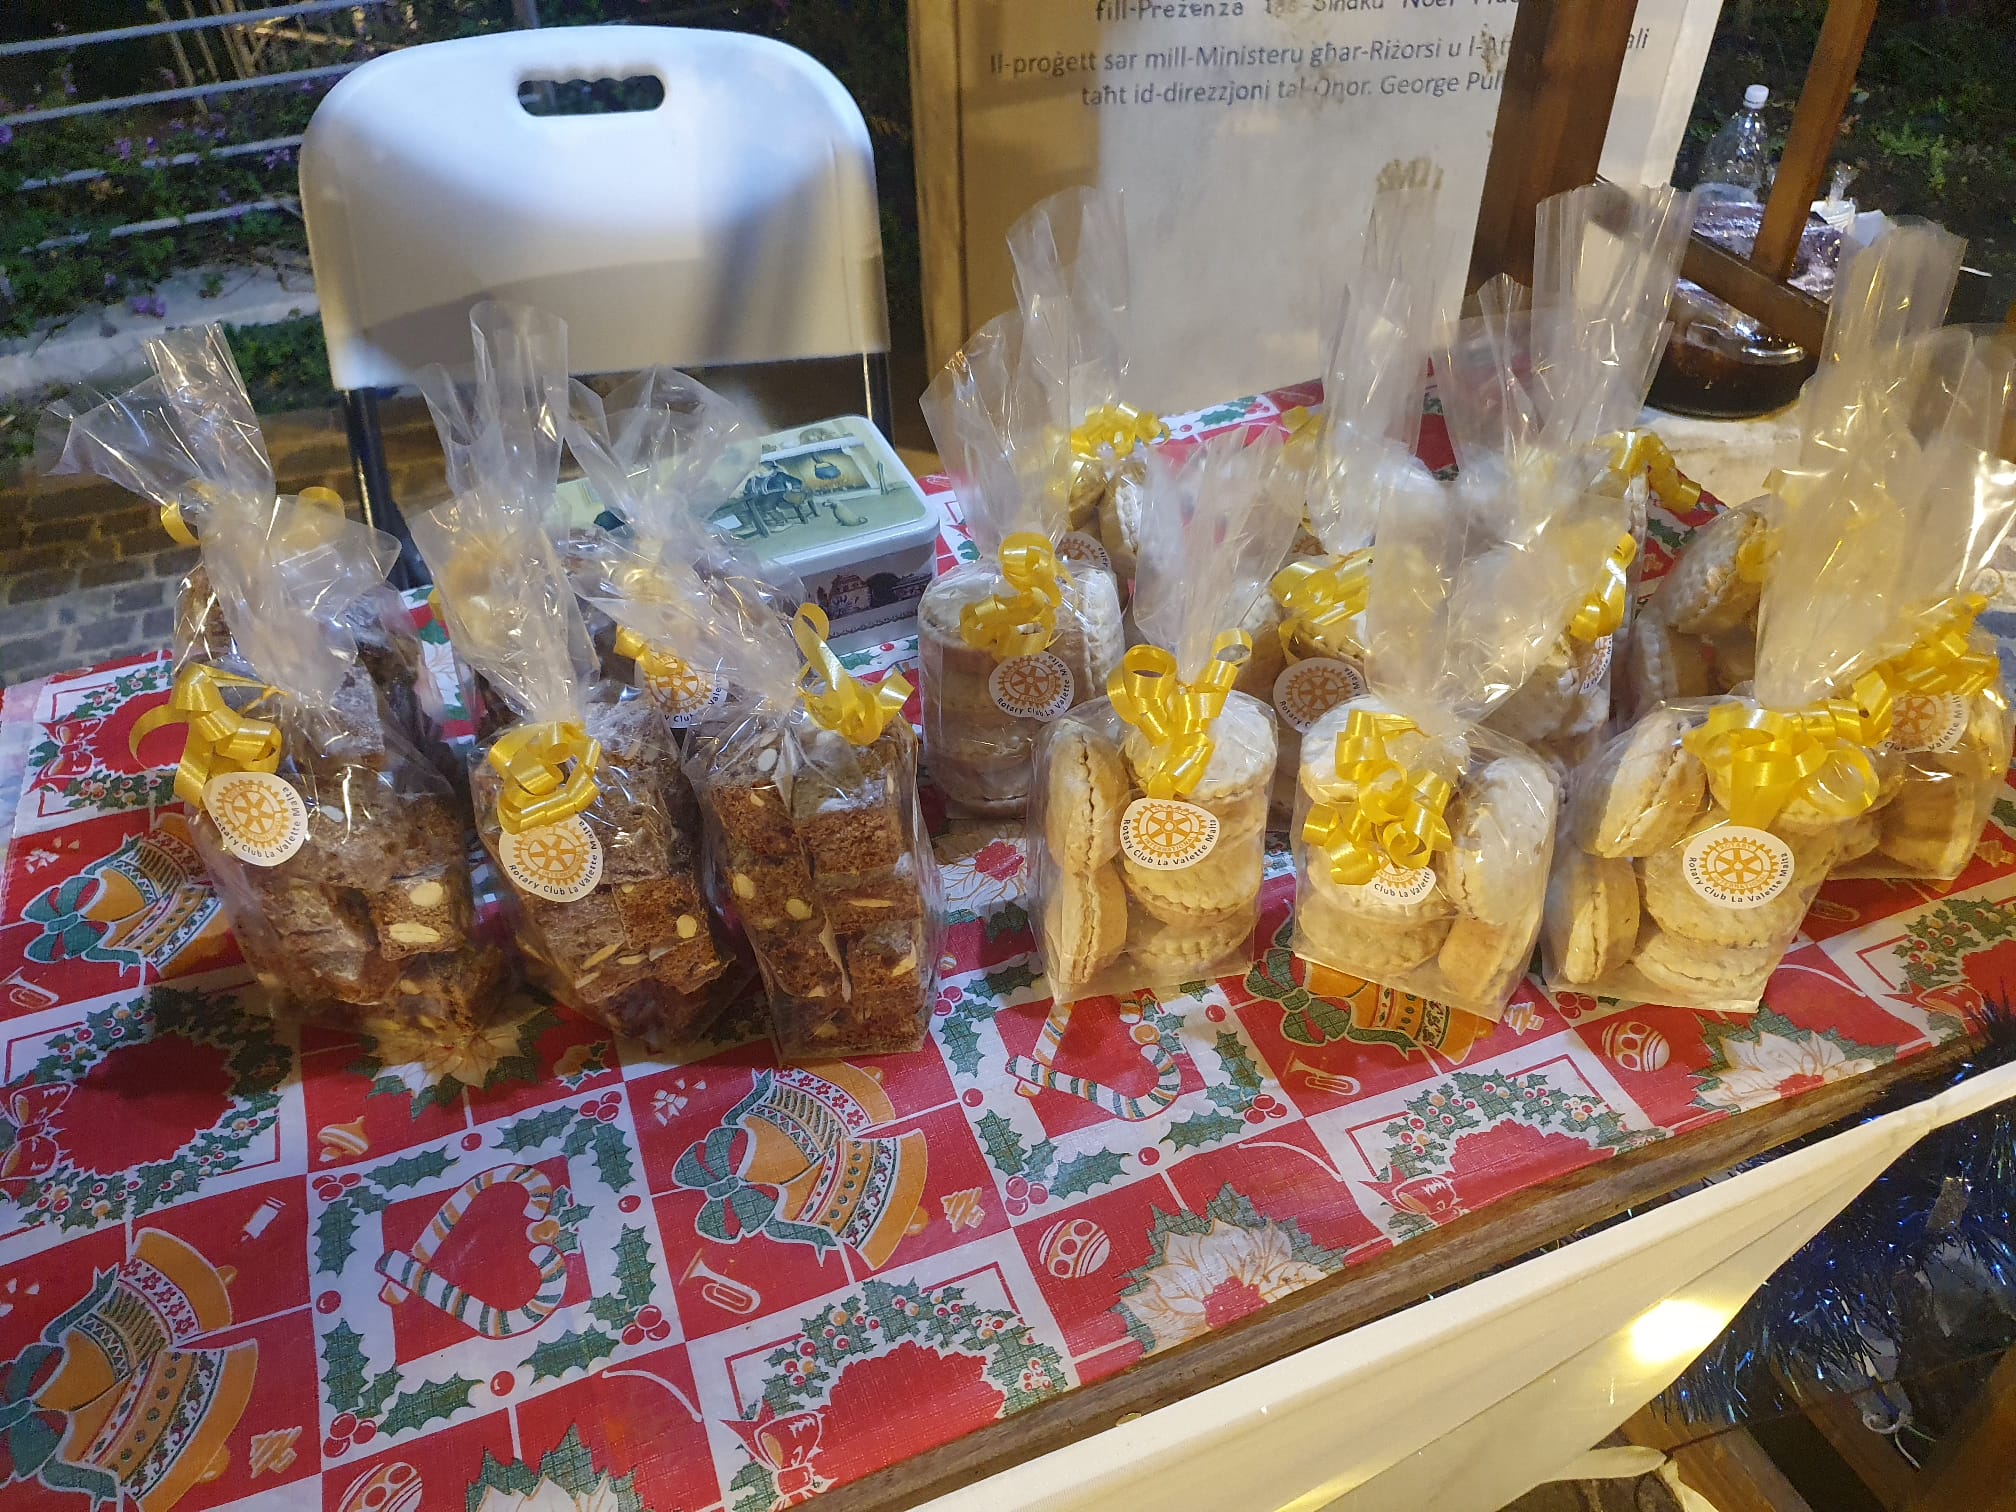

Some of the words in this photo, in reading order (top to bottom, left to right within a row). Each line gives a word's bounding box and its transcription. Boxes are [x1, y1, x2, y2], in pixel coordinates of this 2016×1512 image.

[990, 51, 1097, 79] Il-proġett
[1104, 53, 1137, 71] sar
[1145, 45, 1302, 70] mill-Ministeru
[1310, 38, 1440, 68] għar-Riżorsi
[1448, 41, 1461, 57] u
[1627, 28, 1650, 49] ali
[1082, 84, 1127, 106] taħt
[1134, 80, 1269, 106] id-direzzjoni
[1380, 74, 1459, 97] George
[1466, 71, 1503, 91] Pul
[1048, 655, 1069, 677] Malta
[708, 685, 722, 705] Vale
[997, 698, 1024, 715] Rotary
[1054, 679, 1070, 709] Valette
[1280, 700, 1301, 725] Rotary
[282, 786, 300, 817] Malta
[278, 821, 301, 853] Valette
[578, 821, 598, 850] Malta
[1123, 819, 1134, 850] Rotary
[1133, 849, 1154, 864] Club
[1173, 844, 1208, 865] Valette
[1205, 819, 1217, 843] Malta
[241, 844, 263, 858] Club
[265, 850, 275, 859] La
[508, 864, 540, 889] Rotary
[578, 854, 598, 888] Valette
[1689, 856, 1704, 886] Rotary
[1704, 886, 1727, 900] Club
[1747, 880, 1782, 902] Valette
[1779, 852, 1788, 877] Malta
[543, 885, 566, 895] Club
[568, 887, 579, 895] La
[1374, 883, 1396, 897] Club
[1399, 890, 1409, 898] La
